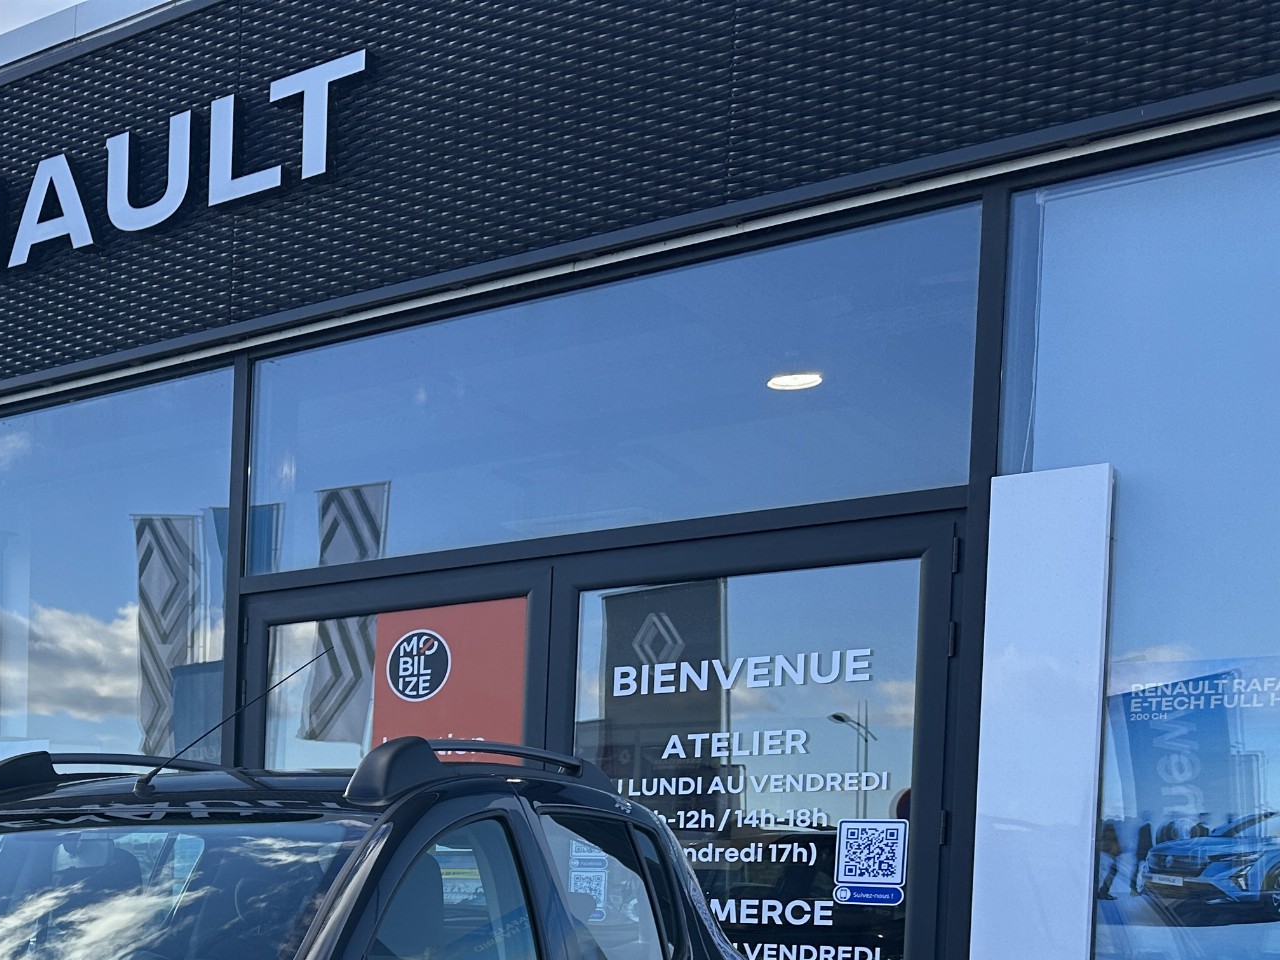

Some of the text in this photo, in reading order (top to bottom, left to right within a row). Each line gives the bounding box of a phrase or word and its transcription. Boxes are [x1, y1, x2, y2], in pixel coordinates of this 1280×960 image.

[613, 648, 873, 697] BIENVENUE
[1131, 680, 1227, 697] RENAULT
[1130, 696, 1205, 712] E-TECH
[1210, 693, 1264, 709] FULL
[1130, 712, 1168, 721] 200 CH
[661, 729, 809, 759] ATELIER
[628, 777, 702, 797] LUNDI
[707, 775, 744, 795] AU
[750, 771, 889, 793] VENDREDI
[735, 807, 828, 828] 14h-18h
[769, 843, 817, 866] 17h)
[709, 898, 834, 926] MERCE
